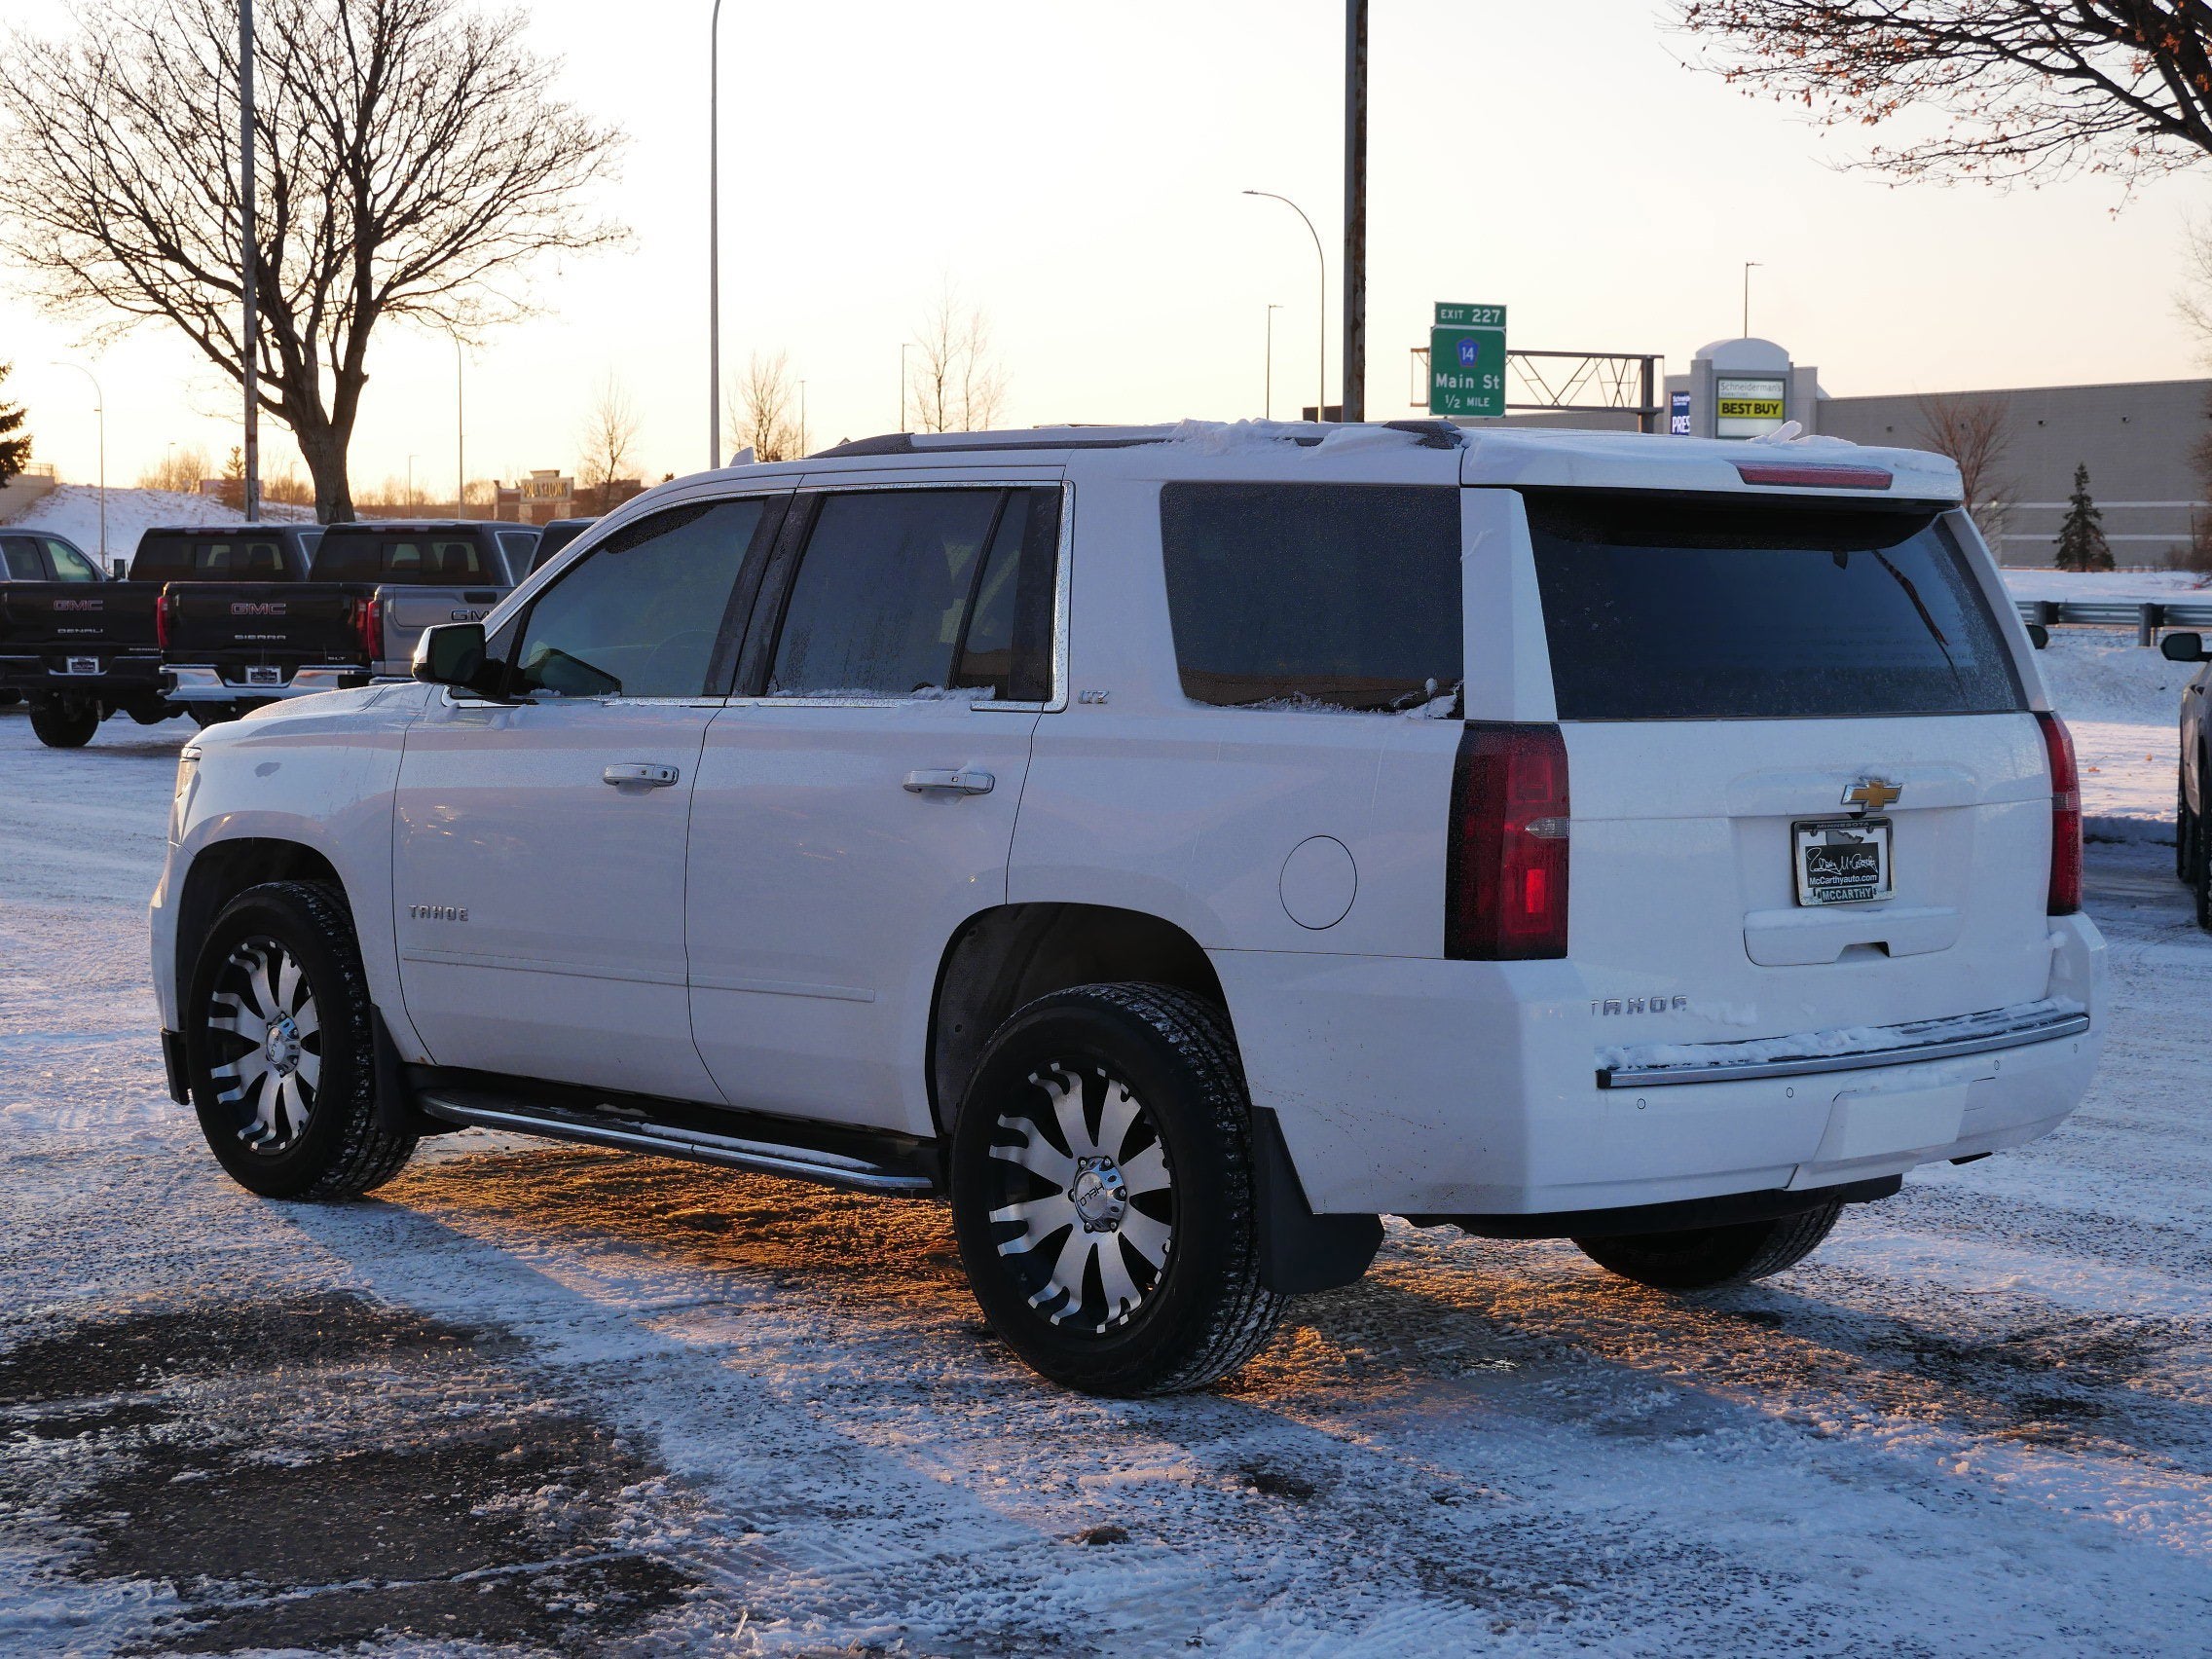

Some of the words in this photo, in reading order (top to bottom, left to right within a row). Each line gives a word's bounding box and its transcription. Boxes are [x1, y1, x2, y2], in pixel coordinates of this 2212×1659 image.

[1440, 309, 1464, 319] EXIT
[1471, 309, 1501, 323] 227
[1461, 346, 1474, 361] 14
[1435, 373, 1474, 389] Main
[1483, 374, 1500, 389] St
[1720, 382, 1783, 392] Schneiderman's
[1466, 397, 1491, 408] MILE
[1721, 403, 1752, 415] BEST
[1753, 403, 1780, 415] BUY
[53, 599, 104, 611] GMC
[230, 603, 287, 615] GMC
[451, 608, 490, 621] GM
[1809, 874, 1877, 886] McCarthyauto.com
[1822, 887, 1872, 902] MCCARTHY
[408, 904, 469, 922] TAHOE
[1077, 1182, 1105, 1207] HELO
